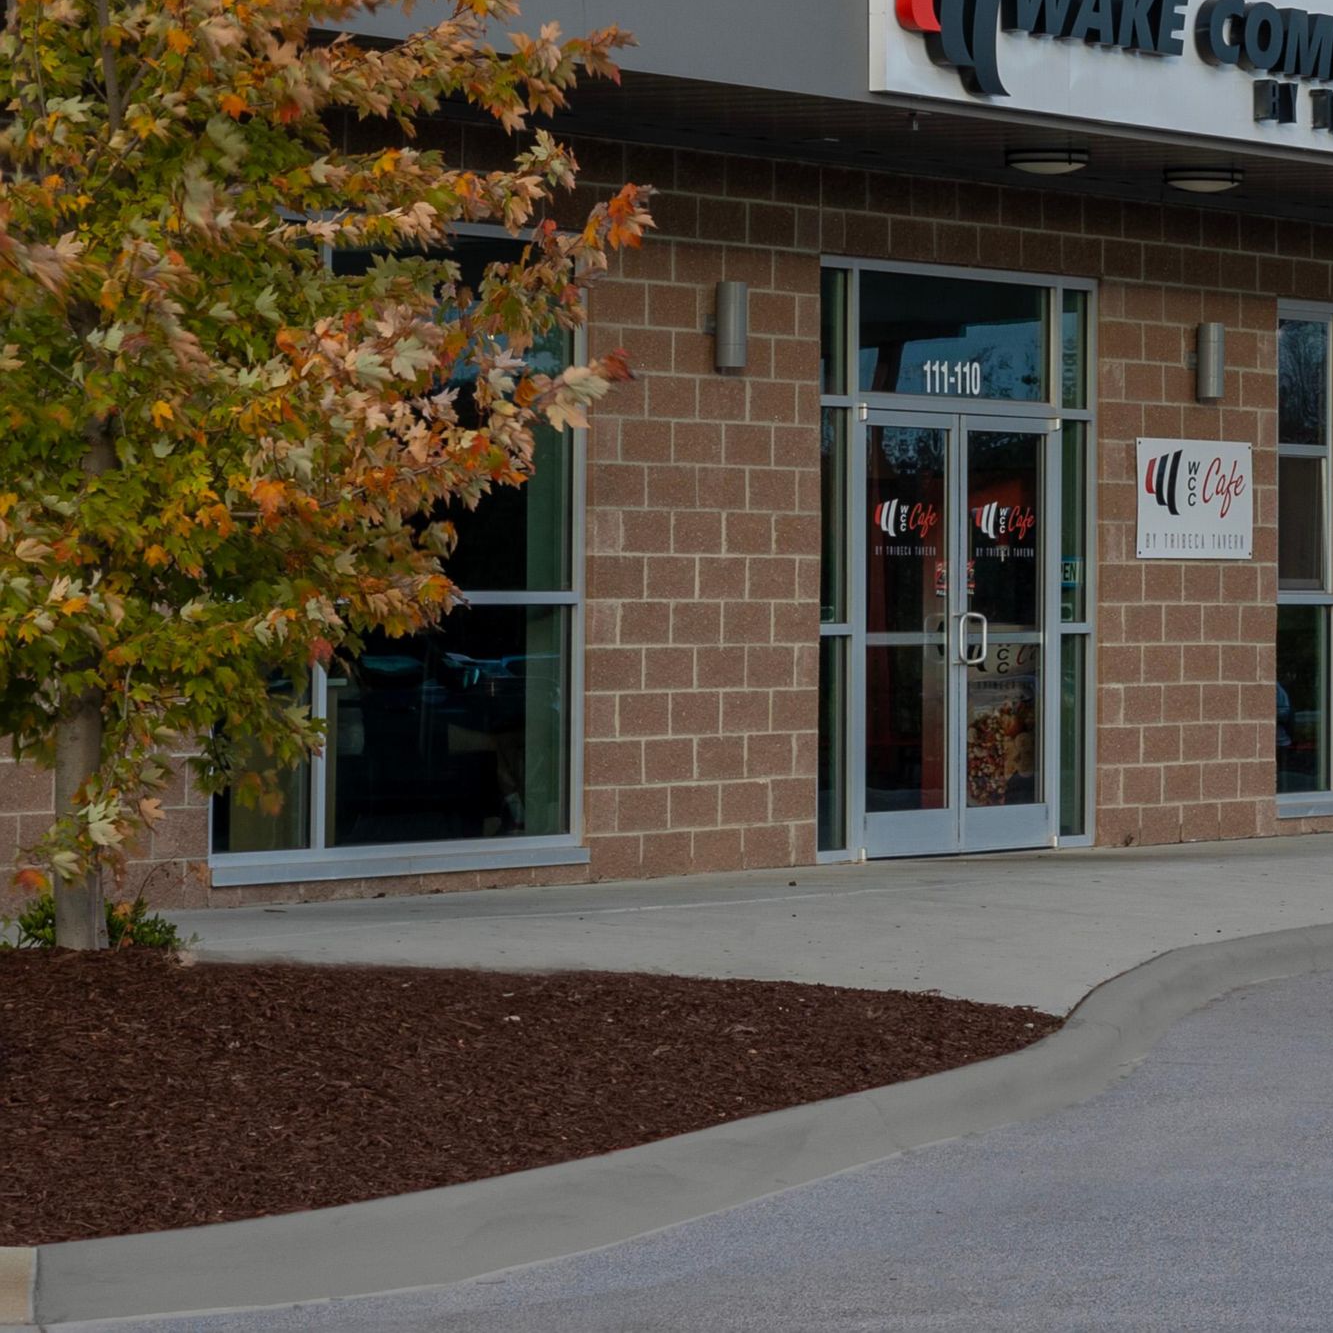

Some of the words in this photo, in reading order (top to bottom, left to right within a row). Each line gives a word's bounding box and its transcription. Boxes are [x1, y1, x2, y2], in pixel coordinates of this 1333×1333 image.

[1253, 79, 1298, 124] BY
[923, 360, 981, 395] 111-110
[1202, 457, 1247, 519] Cafe
[909, 503, 938, 538] Cafe
[1008, 506, 1036, 540] Cafe
[1146, 533, 1157, 549] BY
[1164, 533, 1205, 549] TRIBECA
[1212, 534, 1244, 550] TAVERN
